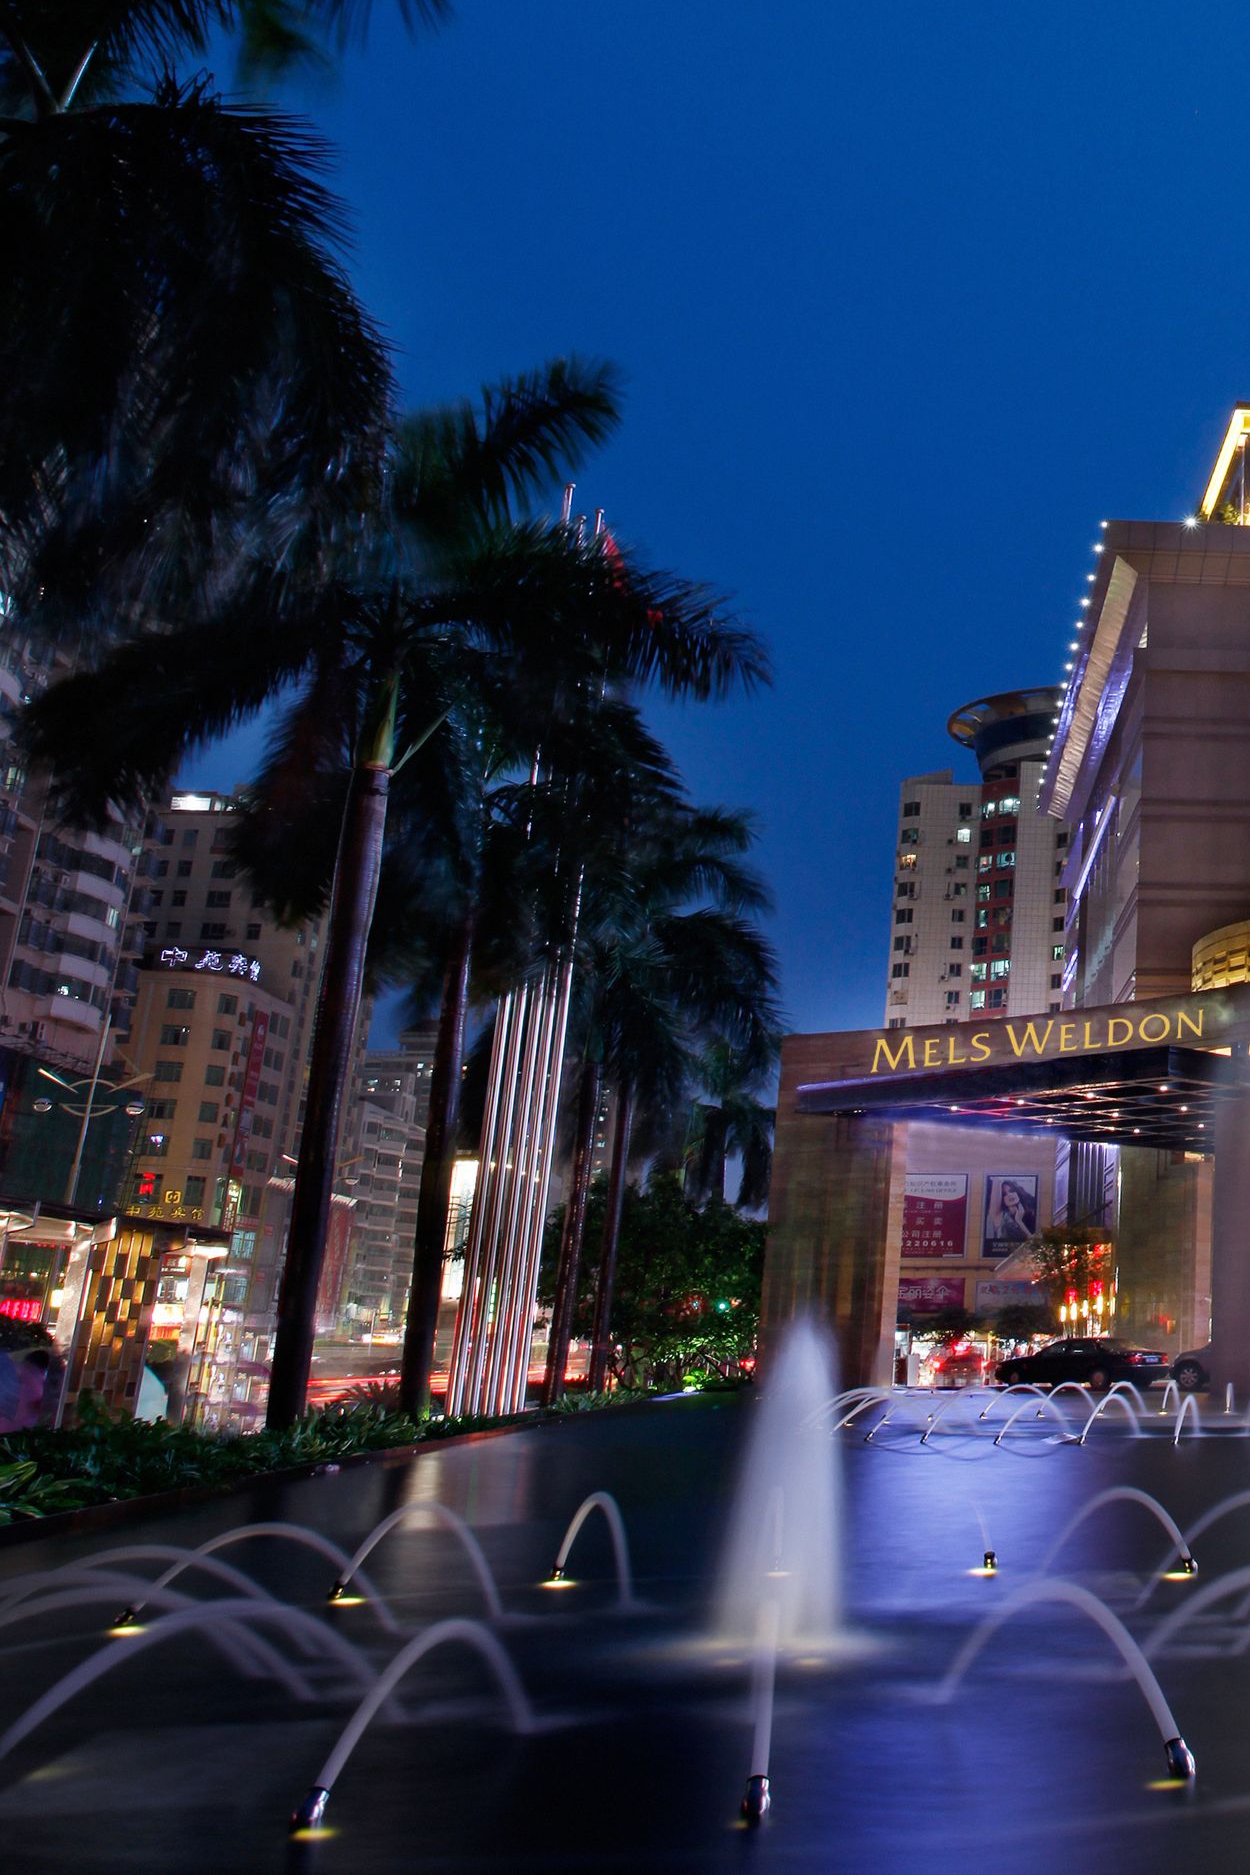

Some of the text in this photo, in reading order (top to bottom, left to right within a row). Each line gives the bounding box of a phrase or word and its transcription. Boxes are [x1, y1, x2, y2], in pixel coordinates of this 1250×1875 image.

[870, 1009, 1205, 1074] MELS WELDON
[126, 1205, 205, 1220] 中苑宾馆
